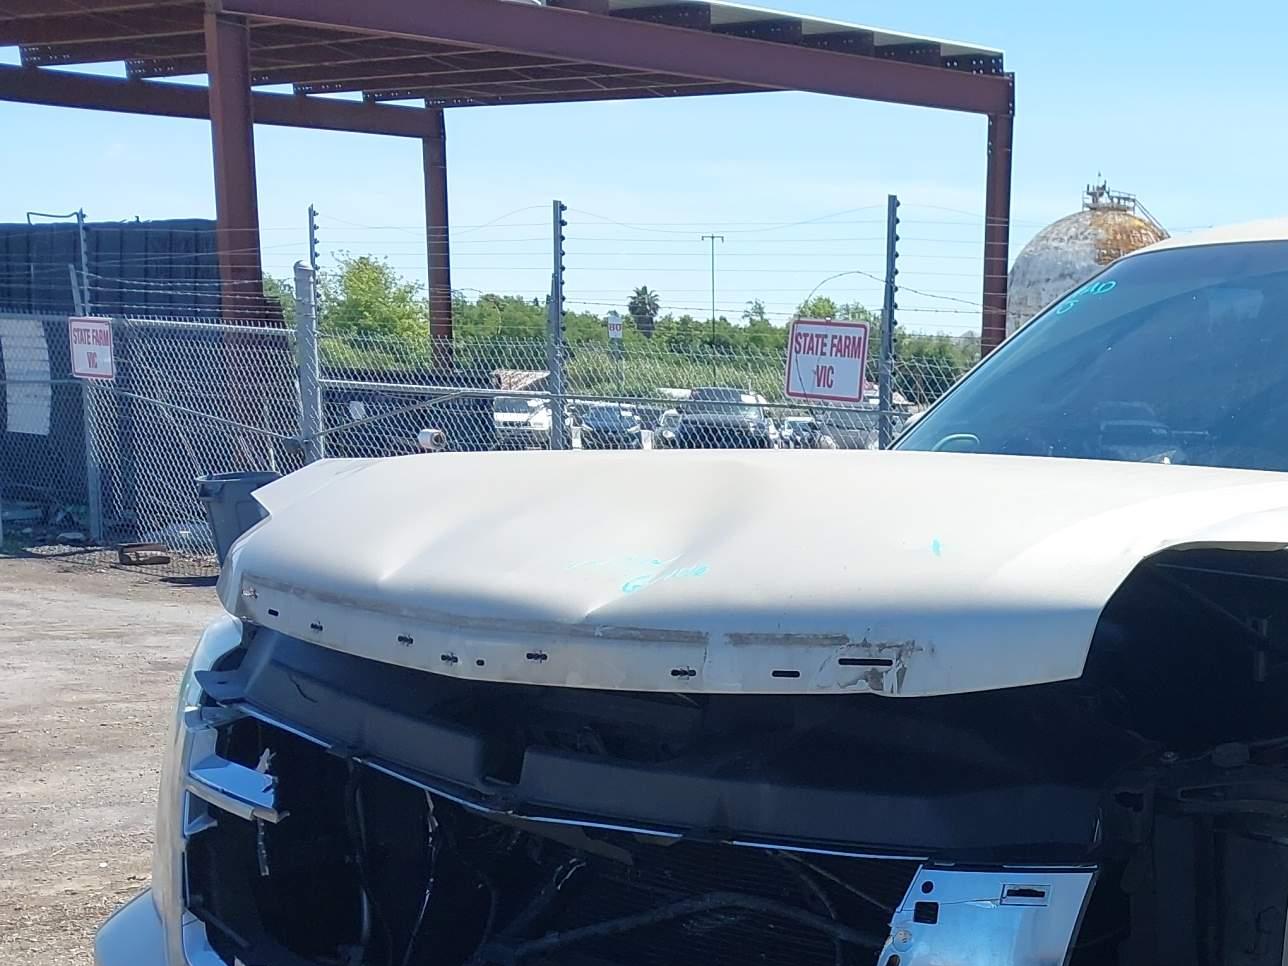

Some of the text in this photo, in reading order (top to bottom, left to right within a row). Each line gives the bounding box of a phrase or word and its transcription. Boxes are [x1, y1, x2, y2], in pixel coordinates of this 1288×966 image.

[73, 327, 110, 346] STATE FARM
[794, 331, 863, 360] STATE FARM
[87, 351, 98, 368] VIC
[815, 364, 835, 389] VIC
